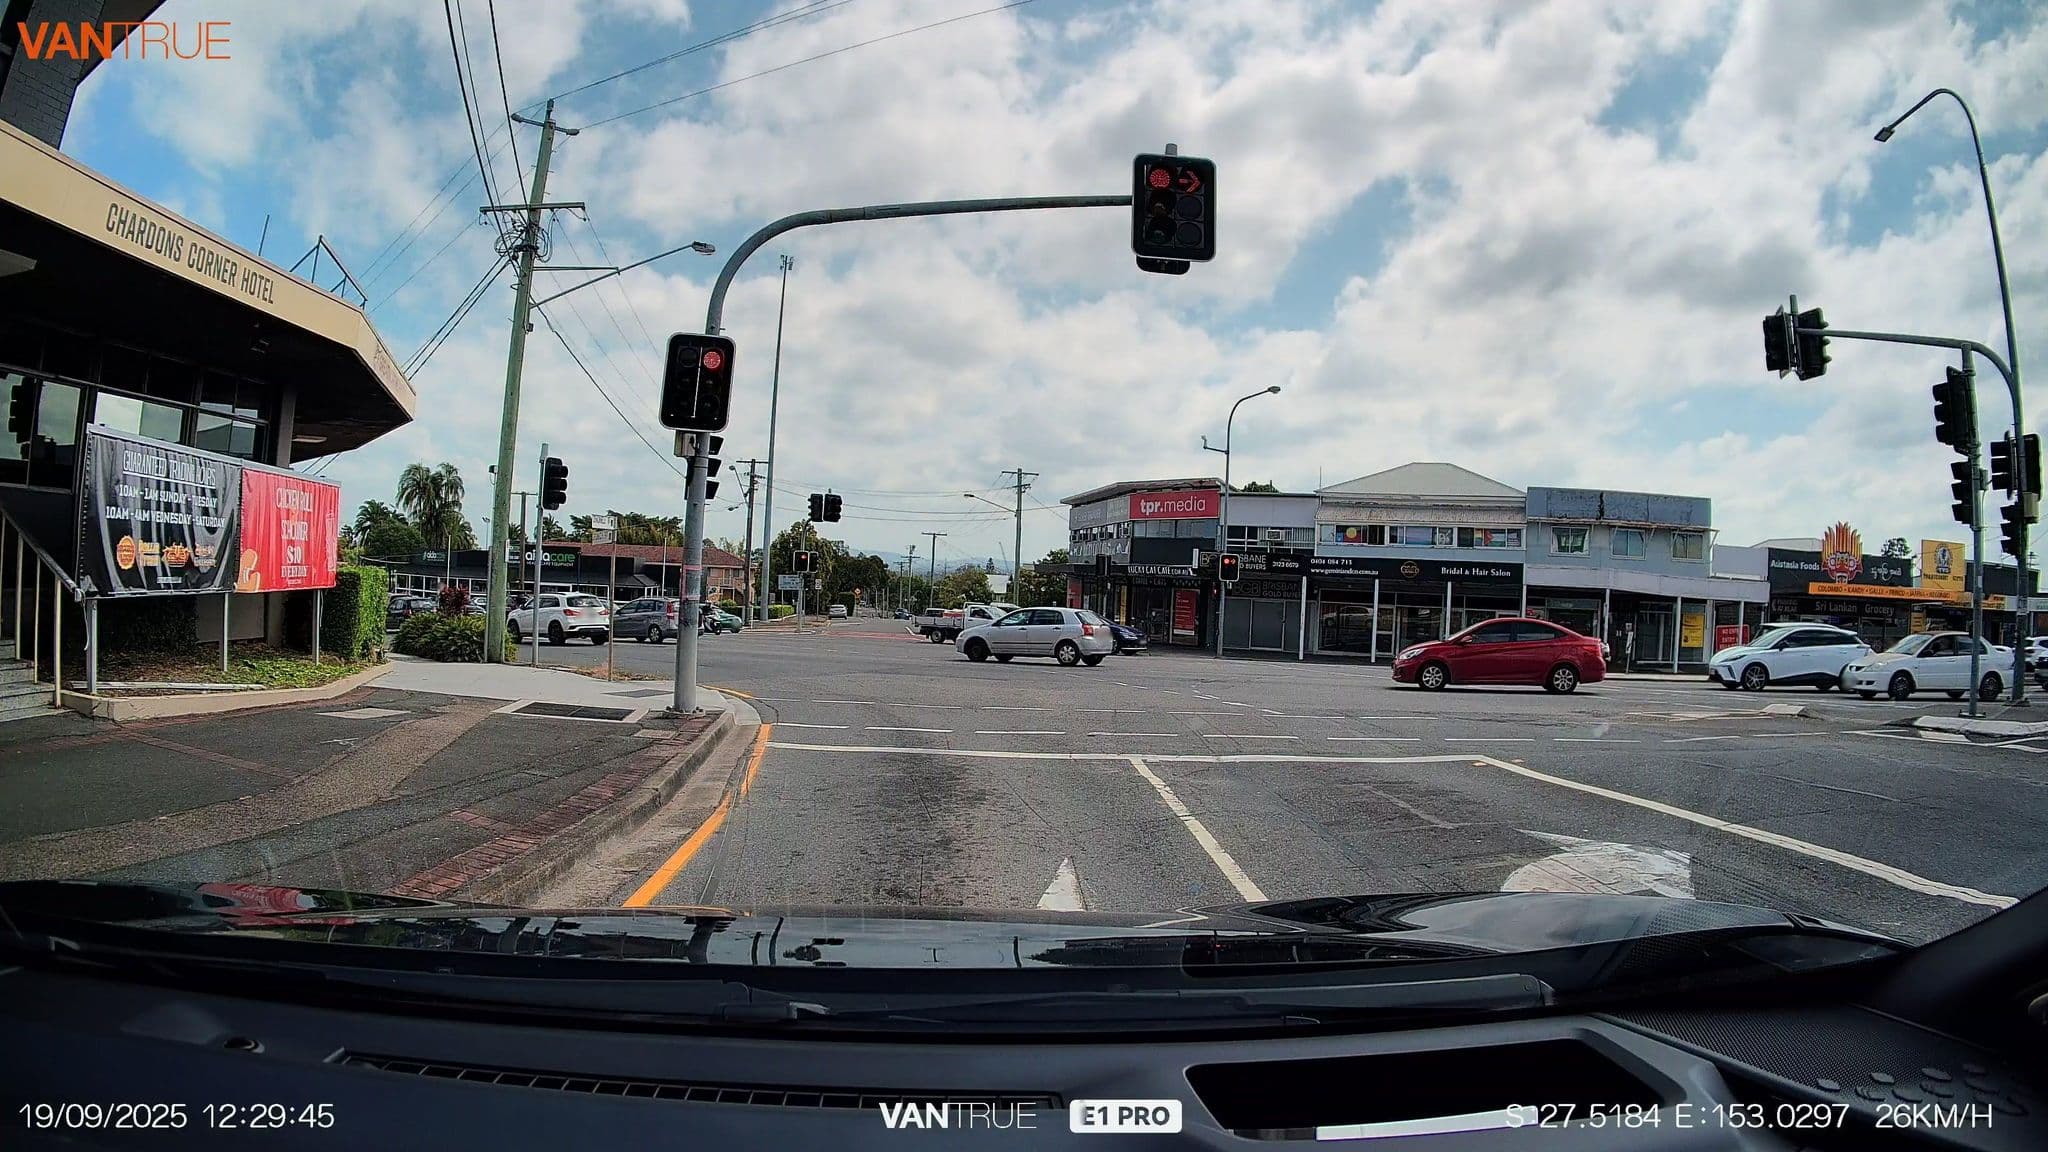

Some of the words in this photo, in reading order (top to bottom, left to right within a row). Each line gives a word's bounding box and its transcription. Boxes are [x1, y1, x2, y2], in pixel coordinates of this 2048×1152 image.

[106, 203, 183, 262] CHARDONS
[187, 242, 238, 288] CORNER
[240, 267, 274, 304] HOTEL
[123, 450, 167, 477] GUARANTEED
[160, 490, 187, 504] SUNDAY
[1141, 496, 1206, 515] tpr.media
[106, 506, 129, 519] 10AM
[151, 510, 191, 525] WEDNESDAY
[196, 515, 225, 528] SATURDAY
[1441, 567, 1463, 575] Bridal
[1472, 568, 1488, 576] Hair
[1801, 562, 1820, 571] Foods
[1815, 602, 1826, 610] Sri
[1829, 602, 1857, 612] Lankan
[1865, 604, 1894, 616] Grocery
